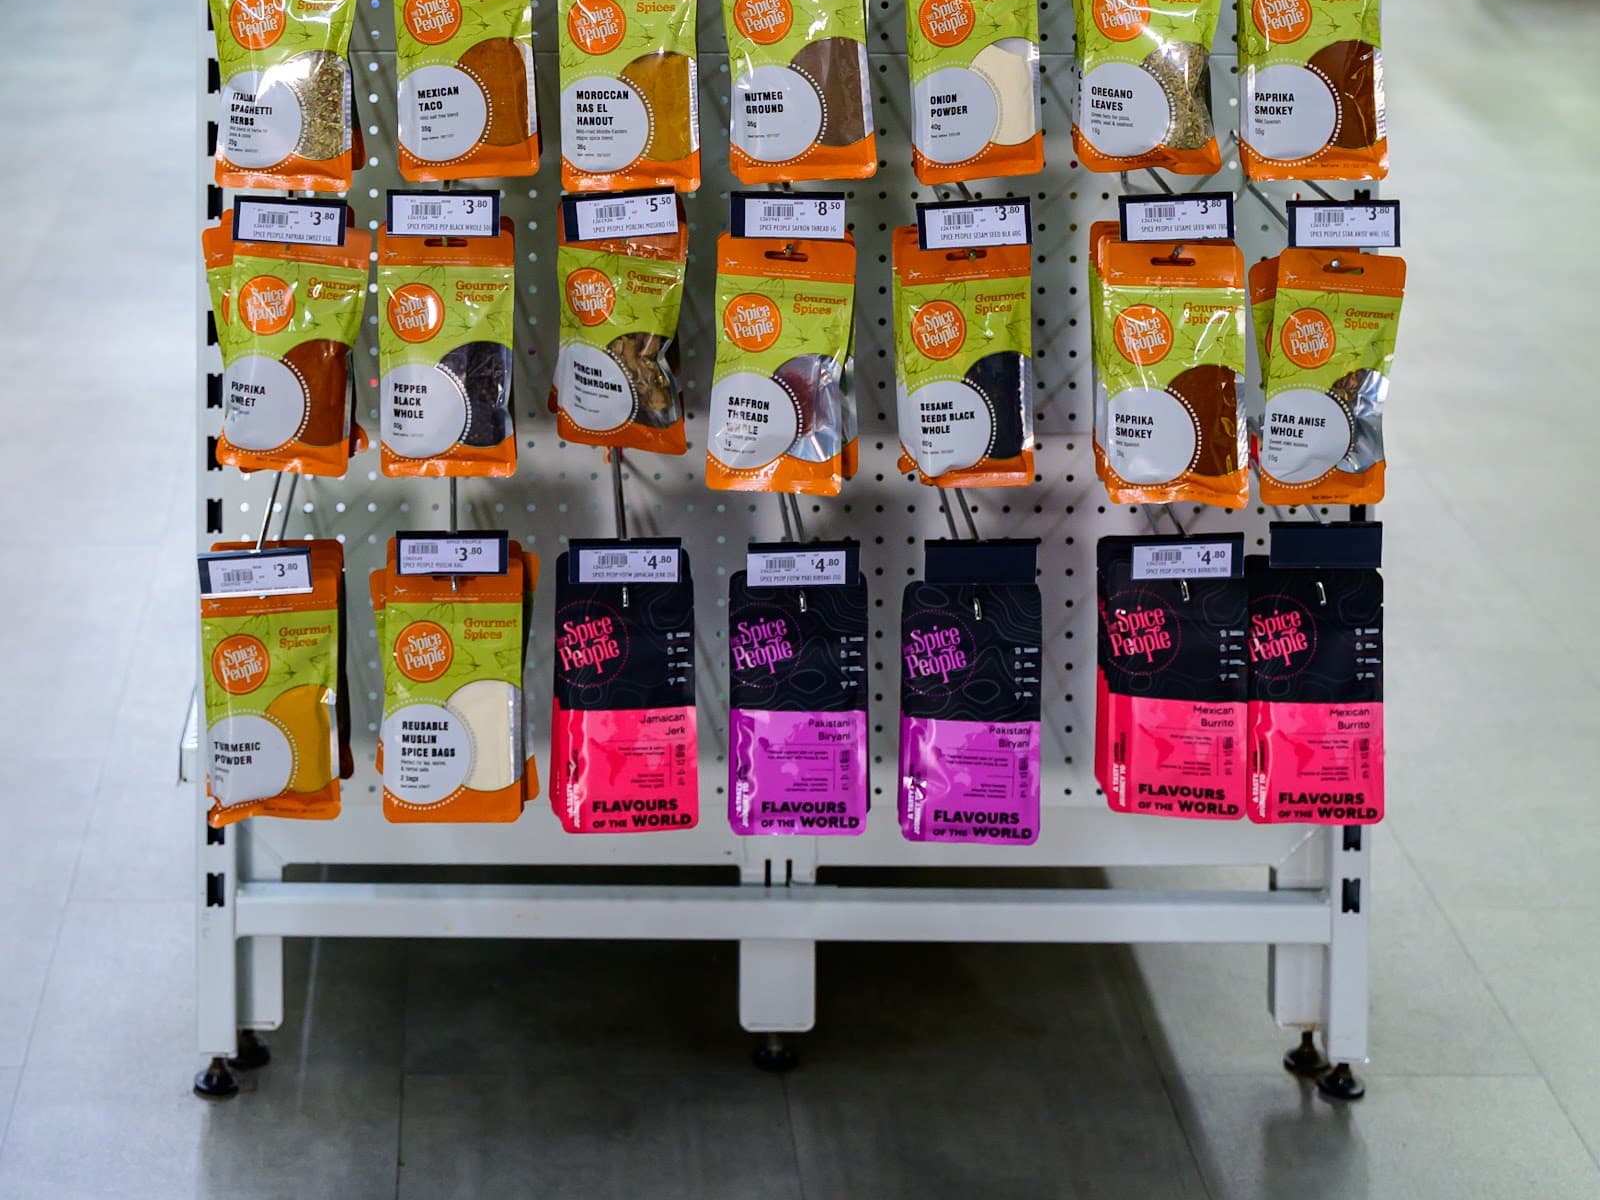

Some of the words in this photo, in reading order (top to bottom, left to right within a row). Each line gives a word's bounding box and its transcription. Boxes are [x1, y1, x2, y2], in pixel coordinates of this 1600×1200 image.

[413, 9, 454, 36] People
[417, 86, 459, 99] MEXICAN
[576, 90, 629, 100] MOROCCAN
[744, 91, 783, 102] NUTMEG
[1091, 86, 1133, 99] OREGANO
[1255, 92, 1294, 102] PAPRIKA
[930, 93, 957, 105] ONION
[1091, 99, 1123, 111] LEAVES
[231, 103, 272, 115] SPAGHETTI
[418, 101, 443, 112] TACO
[576, 103, 594, 113] RAS
[597, 103, 608, 113] EL
[746, 104, 783, 114] GROUND
[931, 105, 968, 118] POWDER
[1254, 105, 1293, 115] SMOKEY
[230, 115, 254, 126] HERBS
[577, 116, 614, 126] HANOUT
[645, 196, 671, 212] $5.50
[814, 201, 840, 216] $8.50
[310, 211, 335, 226] $3.80
[573, 360, 602, 377] PORCINI
[231, 381, 266, 395] PAPRIKA
[394, 382, 427, 394] PEPPER
[574, 373, 622, 393] MUSHROOMS
[230, 394, 256, 407] SWEET
[394, 395, 421, 406] BLACK
[728, 396, 770, 411] SAFFRON
[920, 401, 953, 411] SESAME
[393, 408, 424, 419] WHOLE
[728, 409, 769, 424] THREADS
[921, 413, 947, 423] SEEDS
[949, 411, 975, 421] BLACK
[1115, 413, 1154, 426] PAPRIKA
[1271, 413, 1295, 424] STAR
[1298, 416, 1326, 427] ANISE
[921, 425, 950, 435] WHOLE
[1116, 426, 1152, 439] SMOKEY
[1270, 426, 1304, 438] WHOLE
[455, 547, 482, 562] $3.80
[1197, 550, 1225, 565] $4.80
[643, 555, 672, 570] $4.80
[811, 558, 839, 573] $4.80
[564, 615, 614, 647] Spice
[910, 625, 961, 655] Spice
[558, 635, 620, 675] People
[905, 644, 967, 684] People
[1193, 705, 1234, 715] Mexican
[1329, 708, 1370, 717] Mexican
[640, 713, 686, 724] Jamaican
[808, 718, 852, 728] Pakistani
[1200, 718, 1234, 728] Burrito
[402, 721, 448, 731] REUSABLE
[665, 726, 685, 736] Jerk
[1337, 720, 1371, 730] Burrito
[402, 734, 437, 744] MUSLIN
[818, 731, 851, 742] Biryani
[213, 741, 261, 752] TURMERIC
[998, 738, 1030, 750] Biryani
[401, 747, 428, 757] SPICE
[431, 748, 455, 757] BAGS
[214, 754, 252, 765] POWDER
[1138, 783, 1225, 801] FLAVOURS
[1279, 792, 1365, 805] FLAVOURS
[592, 798, 678, 813] FLAVOURS
[761, 801, 847, 814] FLAVOURS
[1138, 801, 1152, 809] OF
[1154, 802, 1173, 811] THE
[1178, 800, 1239, 816] WORLD
[934, 809, 1020, 825] FLAVOURS
[1278, 810, 1292, 818] OF
[1294, 810, 1313, 818] THE
[1317, 807, 1378, 819] WORLD
[592, 820, 606, 829] OF
[608, 819, 627, 828] THE
[632, 813, 692, 827] WORLD
[761, 818, 775, 828] OF
[777, 819, 795, 828] THE
[800, 815, 860, 829] WORLD
[932, 828, 947, 836] OF
[949, 828, 968, 837] THE
[972, 826, 1032, 840] WORLD
